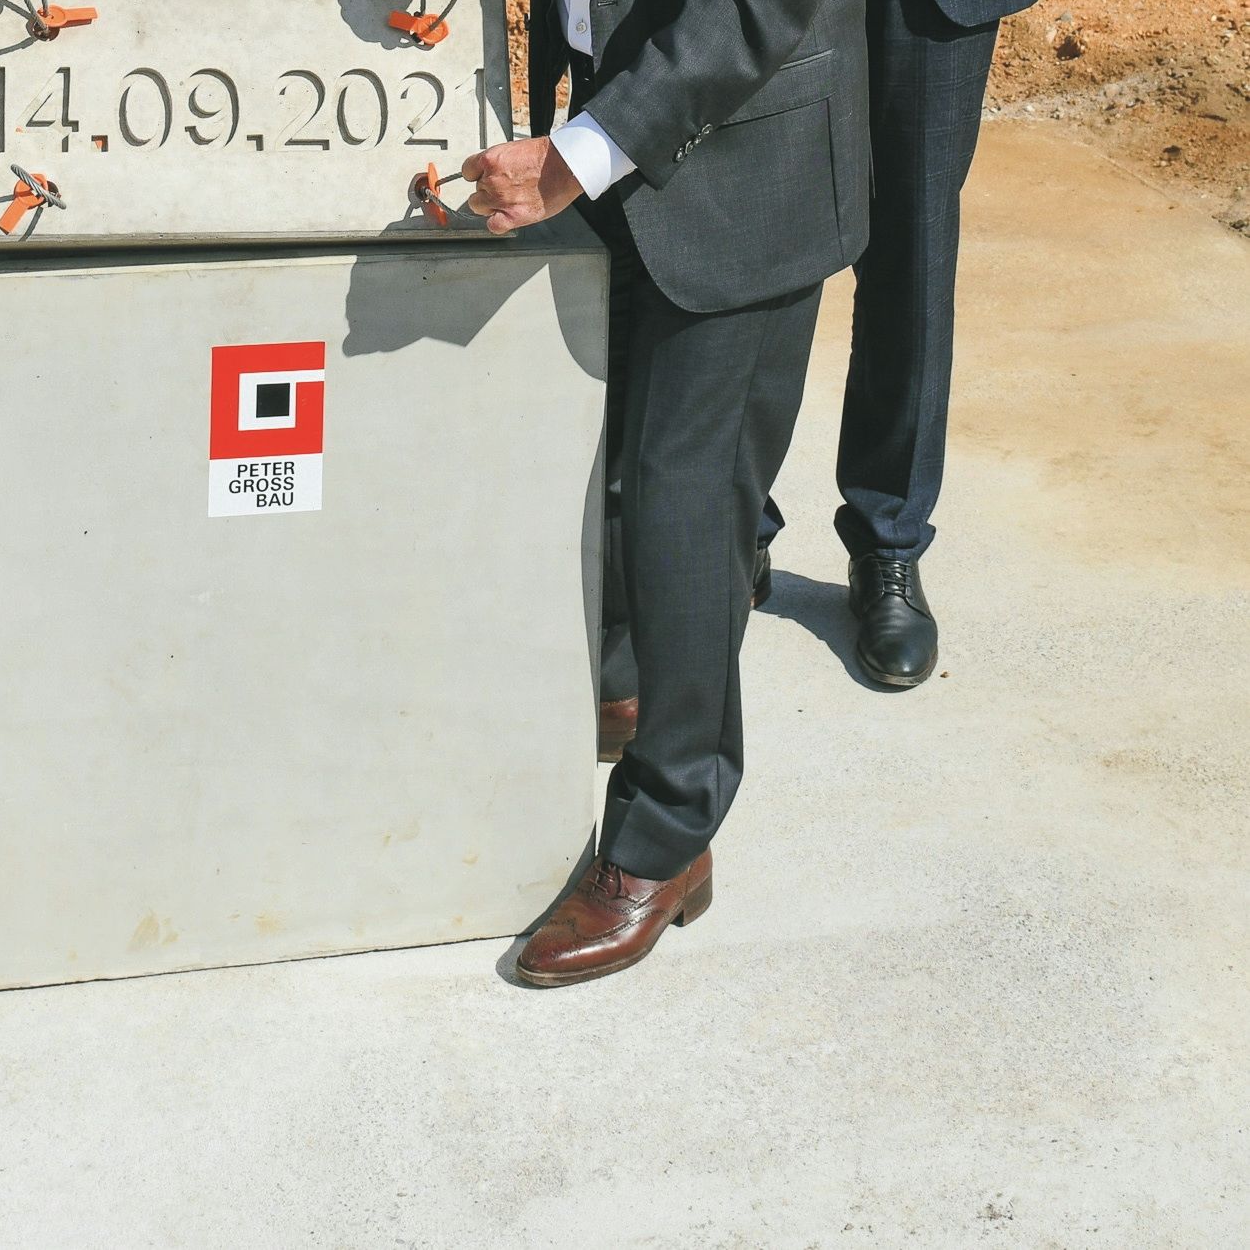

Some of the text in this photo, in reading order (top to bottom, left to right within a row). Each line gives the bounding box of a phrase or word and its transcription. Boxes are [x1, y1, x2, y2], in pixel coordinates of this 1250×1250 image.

[237, 461, 295, 478] PETER
[228, 476, 295, 494] GROSS
[256, 492, 294, 507] BAU
